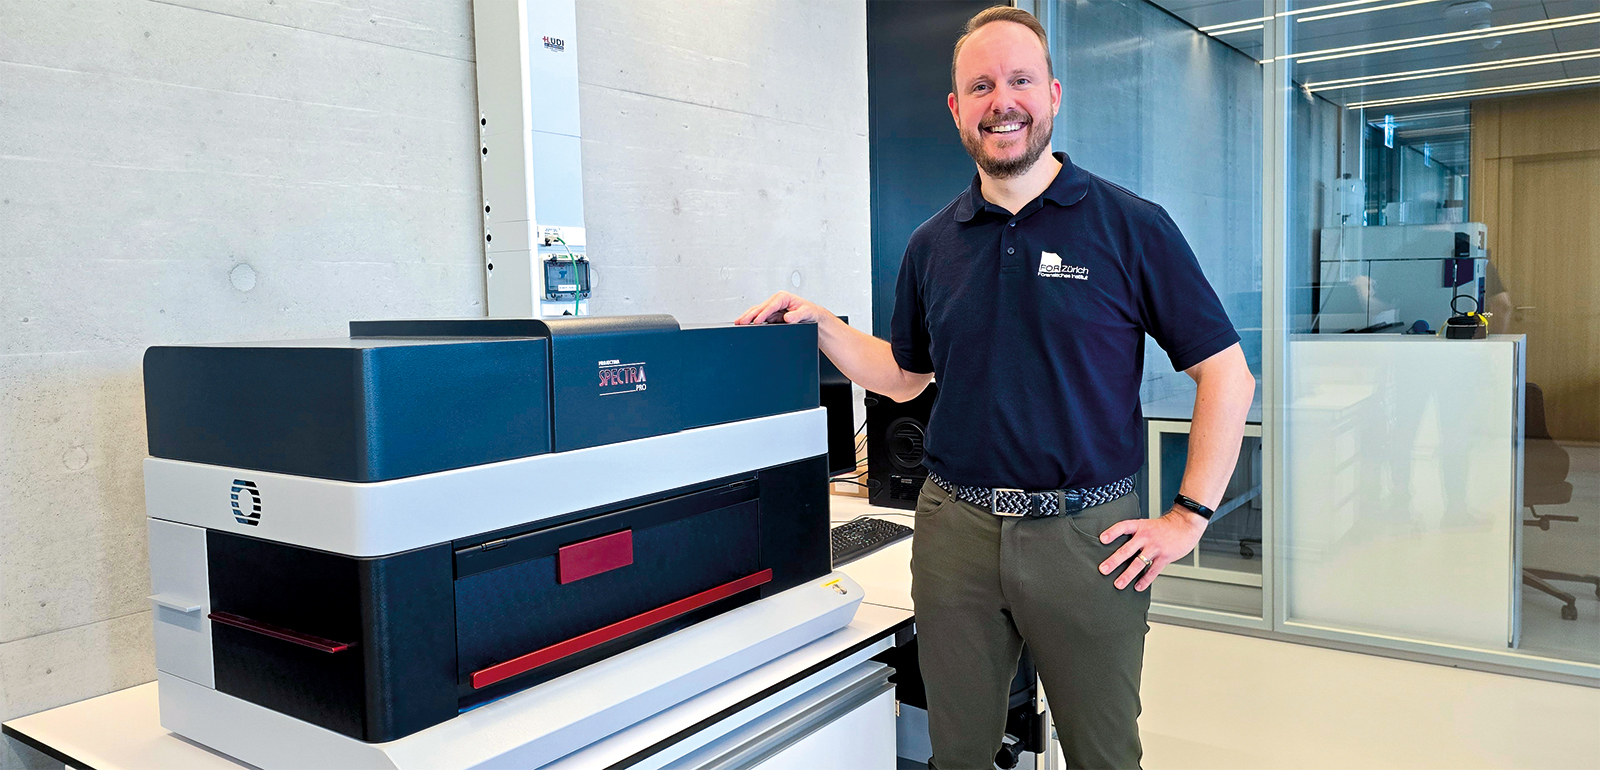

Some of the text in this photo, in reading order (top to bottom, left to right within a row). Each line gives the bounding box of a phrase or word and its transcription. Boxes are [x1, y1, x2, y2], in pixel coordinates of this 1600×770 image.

[1041, 264, 1089, 275] FOR Zürich
[599, 366, 647, 387] SPECTRA
[635, 383, 647, 391] PRO
